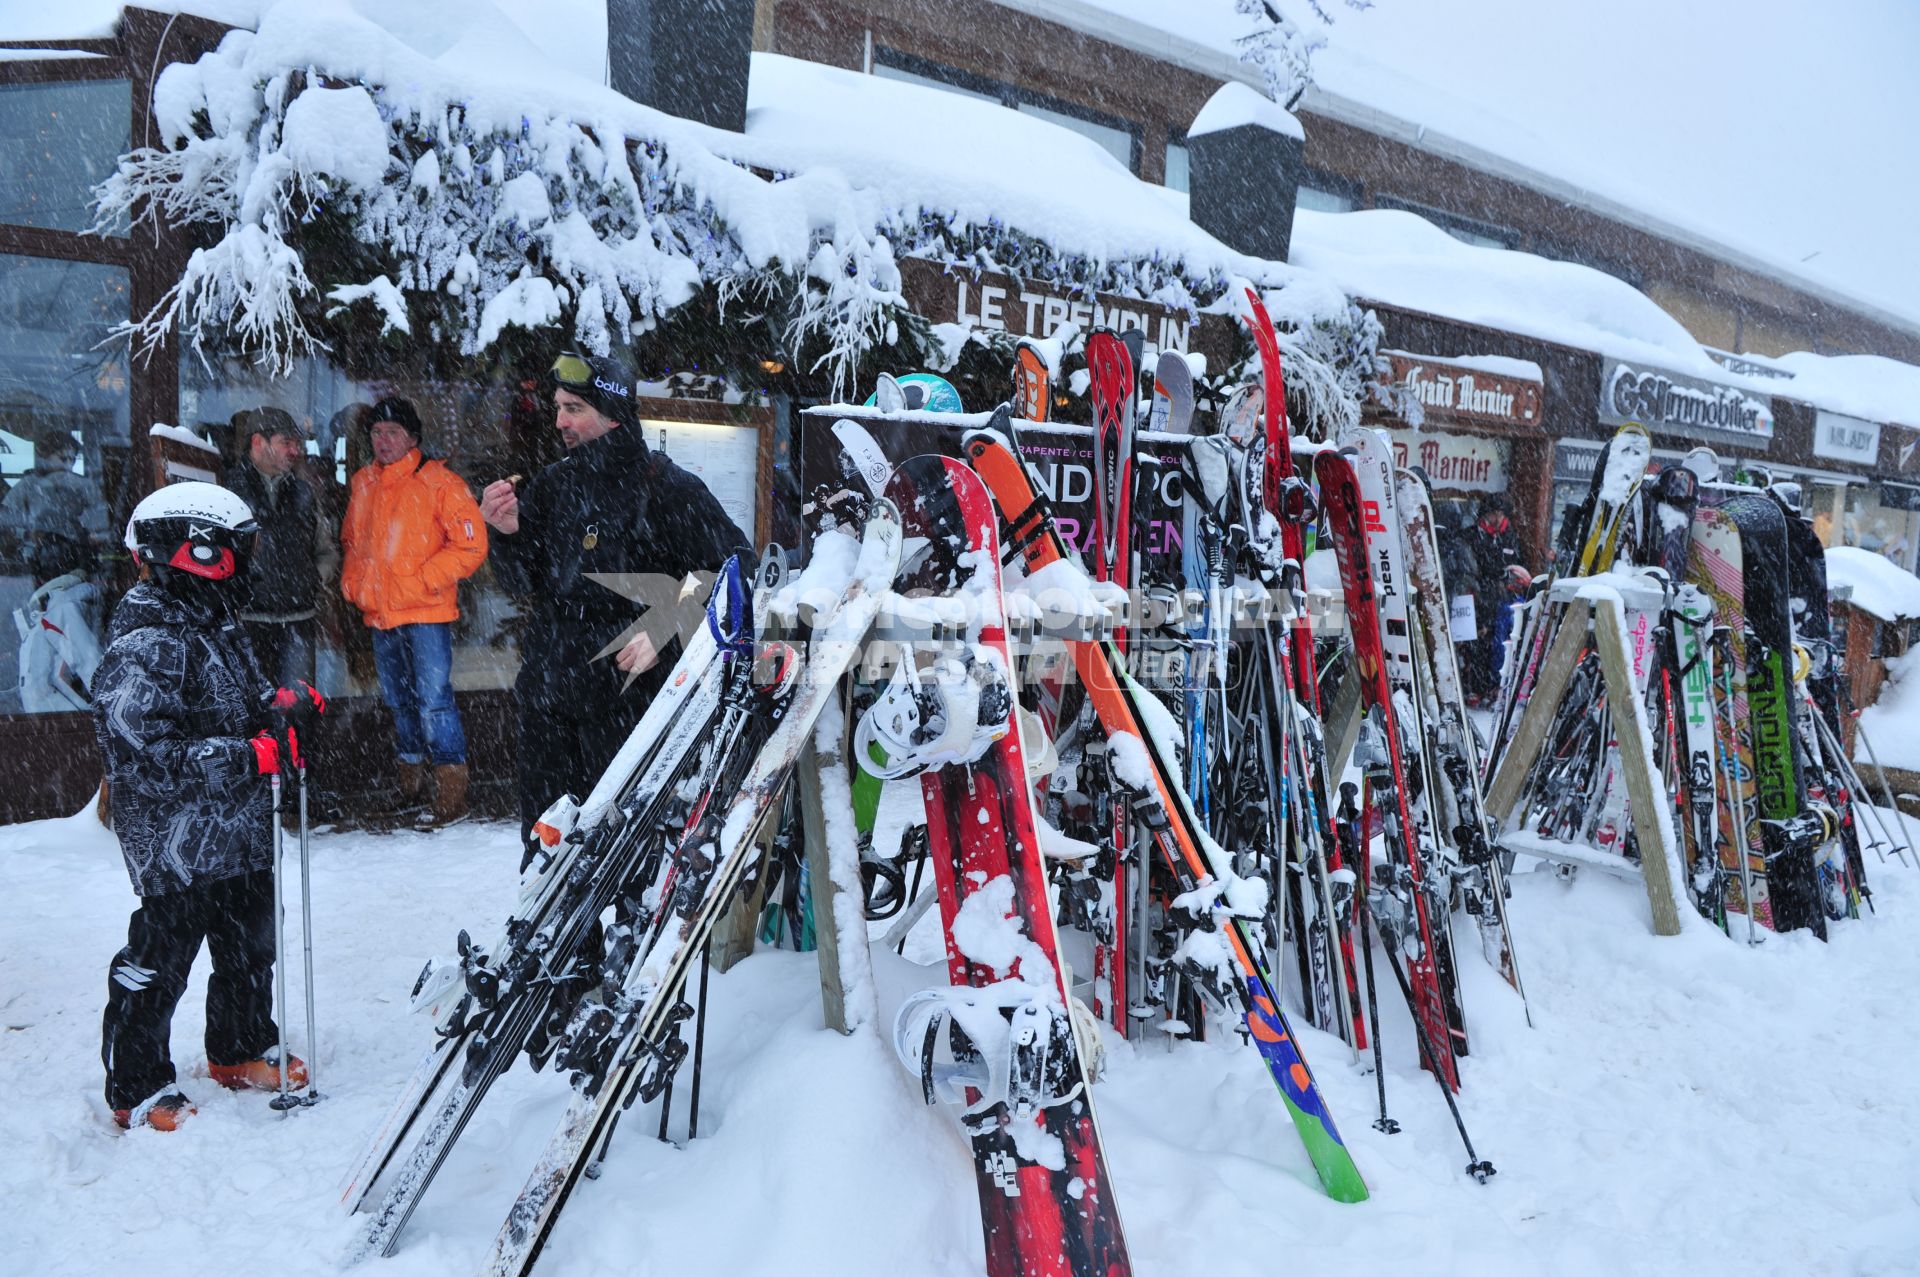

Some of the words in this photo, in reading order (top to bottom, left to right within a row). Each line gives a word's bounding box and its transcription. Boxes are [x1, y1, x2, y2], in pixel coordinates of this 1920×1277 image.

[957, 281, 1006, 329] LE
[594, 375, 628, 397] bollé
[1405, 365, 1454, 408] Grand
[1455, 373, 1515, 418] Marnier
[1107, 449, 1115, 504] ATOMIC
[1380, 461, 1393, 509] HEAD
[1419, 438, 1491, 484] Marnier
[163, 509, 228, 523] SALOMON
[1379, 548, 1397, 597] peak
